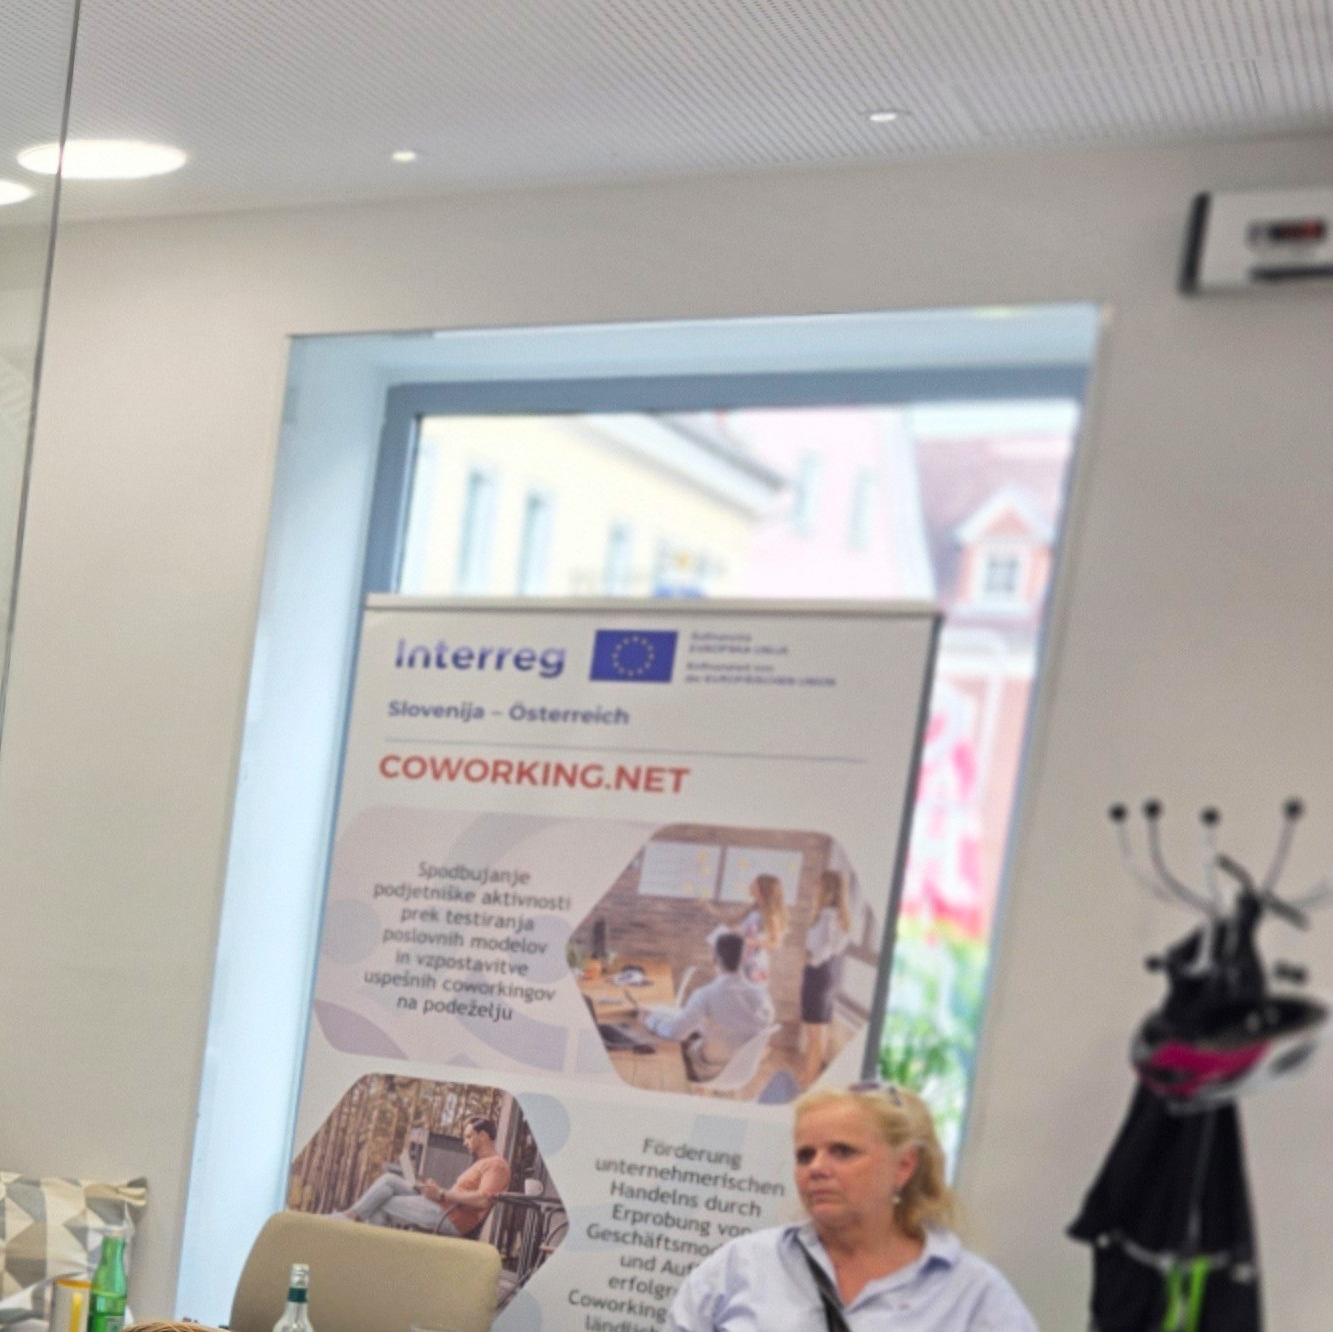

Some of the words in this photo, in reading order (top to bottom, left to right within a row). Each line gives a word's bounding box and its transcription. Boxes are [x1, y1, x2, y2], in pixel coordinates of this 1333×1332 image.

[394, 638, 567, 679] Interreg
[387, 700, 486, 723] Slovenija
[508, 701, 631, 726] Österreich
[378, 753, 691, 794] COWORKING.NET
[418, 861, 531, 887] Spodbujanje
[373, 882, 476, 904] podjetniške
[481, 890, 572, 911] aktivnosti
[400, 907, 439, 923] prek
[446, 909, 535, 934] testiranja
[382, 928, 464, 947] poslovnih
[470, 936, 548, 954] modelov
[395, 950, 410, 965] in
[417, 953, 529, 977] vzpostavitve
[364, 970, 437, 990] uspešnih
[442, 978, 556, 1004] coworkingov
[396, 996, 418, 1010] na
[423, 998, 513, 1022] podeželju
[643, 1137, 743, 1170] Förderung
[595, 1158, 786, 1197] unternehmerischen
[610, 1181, 699, 1208] Handelns
[705, 1196, 762, 1217] durch
[612, 1203, 711, 1237] Erprobung
[620, 1253, 656, 1272] und
[661, 1258, 700, 1277] Auf
